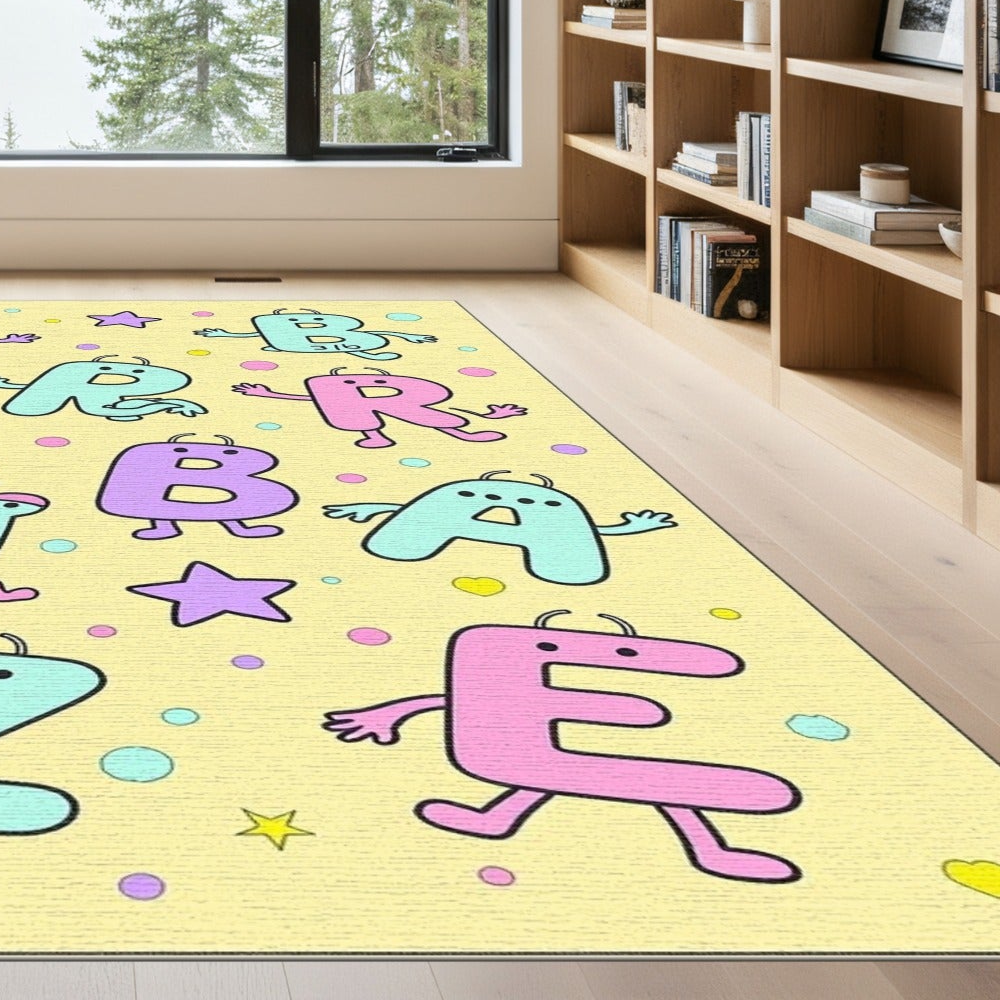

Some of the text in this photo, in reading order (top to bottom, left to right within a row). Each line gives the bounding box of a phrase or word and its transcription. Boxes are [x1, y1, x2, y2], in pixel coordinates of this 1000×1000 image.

[250, 313, 390, 353] B
[1, 361, 192, 417] R
[304, 374, 470, 431] R
[95, 442, 300, 522] B
[361, 479, 610, 586] A
[445, 624, 802, 815] E
